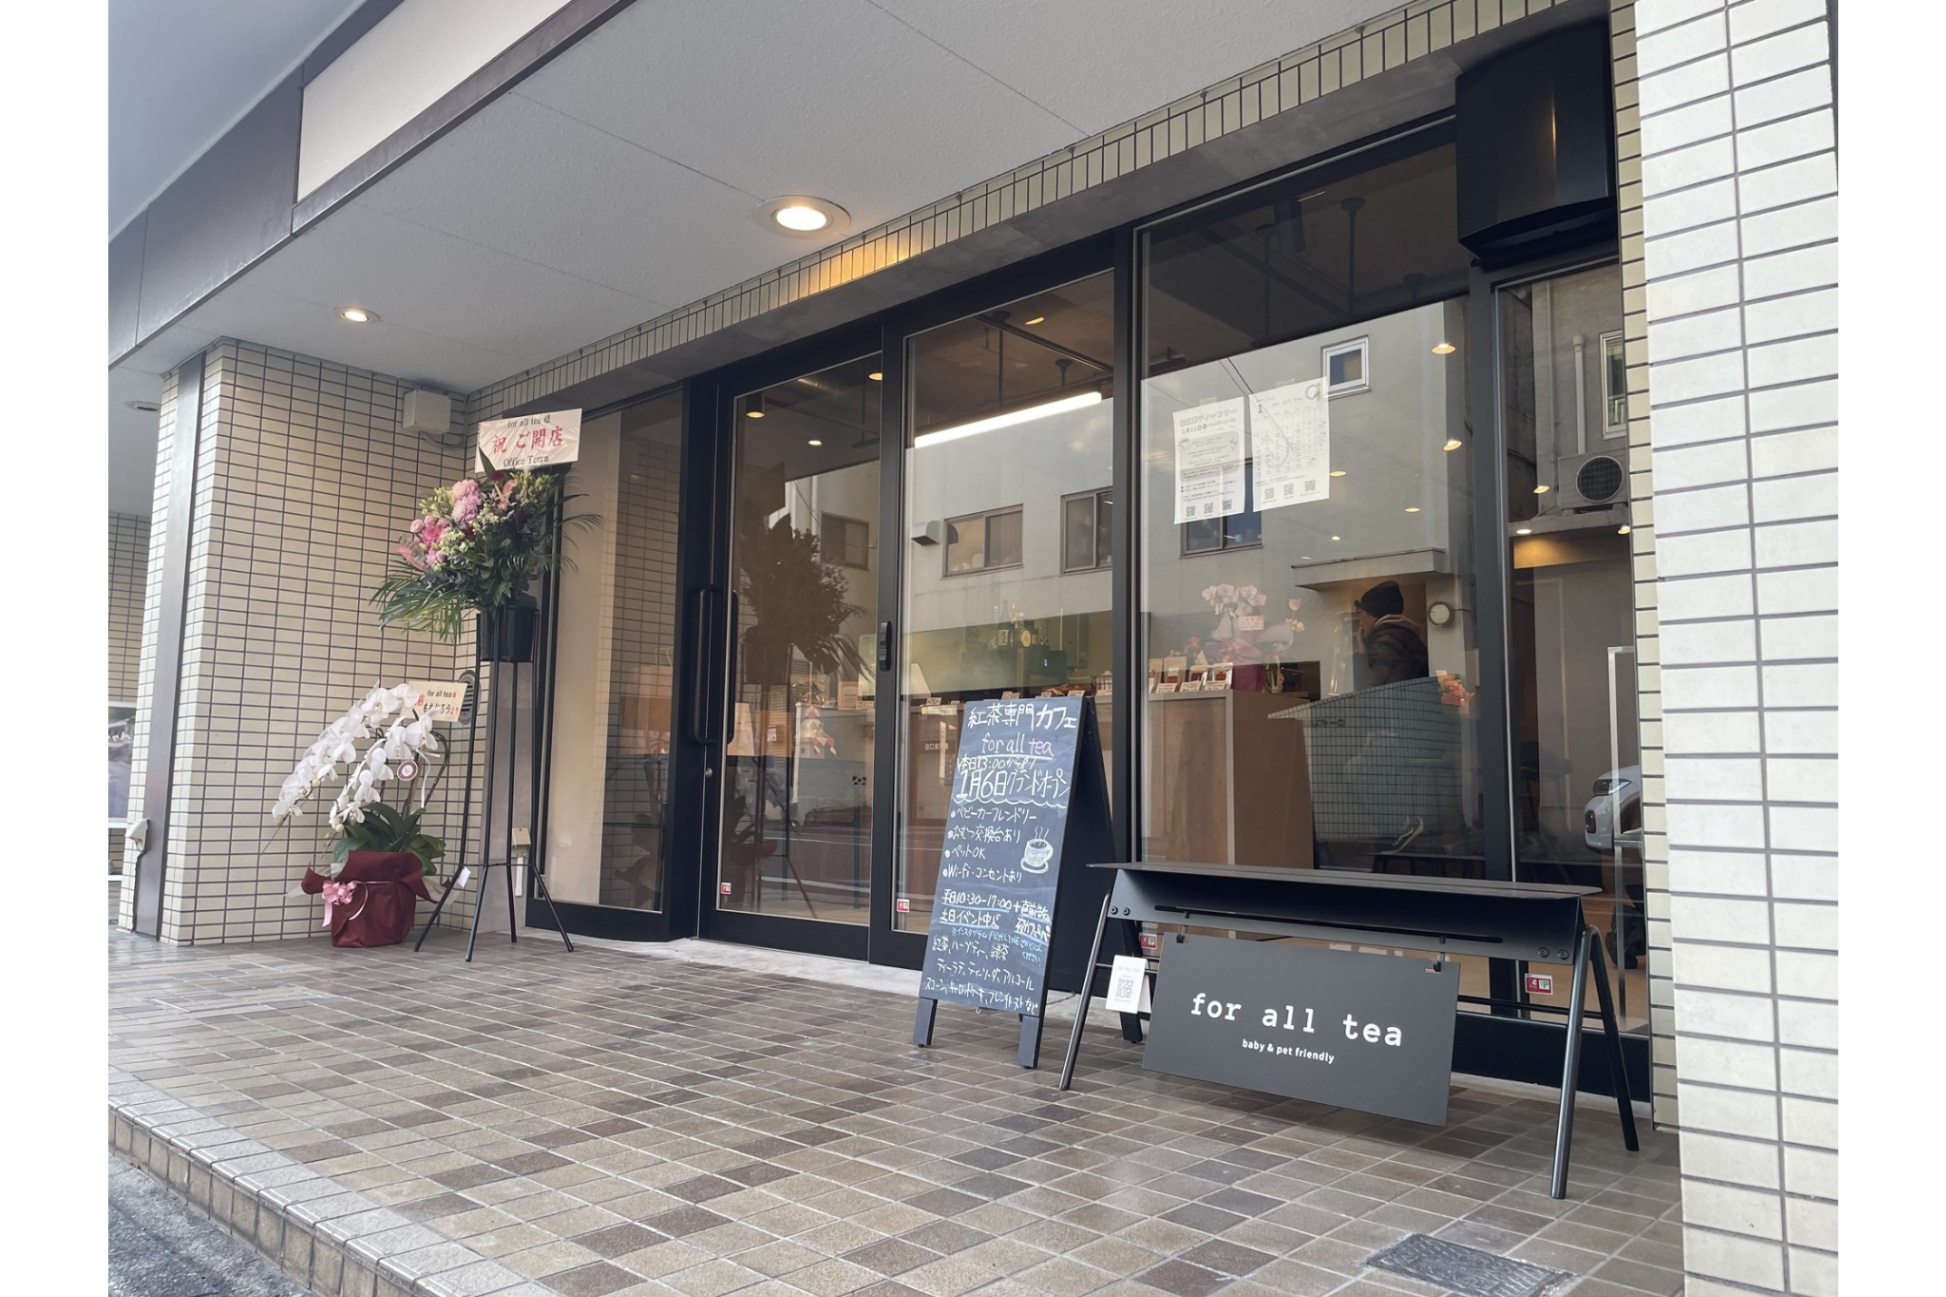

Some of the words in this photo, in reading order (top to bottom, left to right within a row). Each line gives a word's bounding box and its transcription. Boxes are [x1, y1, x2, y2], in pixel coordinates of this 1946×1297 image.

[507, 420, 518, 429] for
[519, 418, 529, 427] all
[531, 417, 541, 425] tea
[492, 435, 508, 454] 祝
[516, 426, 563, 450] ご開店
[503, 457, 526, 468] Office
[435, 690, 443, 698] all
[968, 702, 1077, 731] 紅茶専門カフェ
[981, 732, 1004, 754] for
[1006, 731, 1025, 754] all
[1028, 738, 1054, 757] tea
[956, 768, 1070, 799] 1月6日グランドオープン
[956, 806, 1037, 824] ベビーカーフレンドリー
[952, 823, 1021, 844] おむつ交換台あり
[951, 844, 986, 860] ペットOK
[1190, 992, 1242, 1021] for
[1262, 1005, 1315, 1034] all
[1342, 1013, 1403, 1047] tea
[1241, 1038, 1266, 1053] baby
[1266, 1043, 1275, 1053] &
[1276, 1045, 1294, 1056] pet
[1294, 1047, 1335, 1065] friendly
